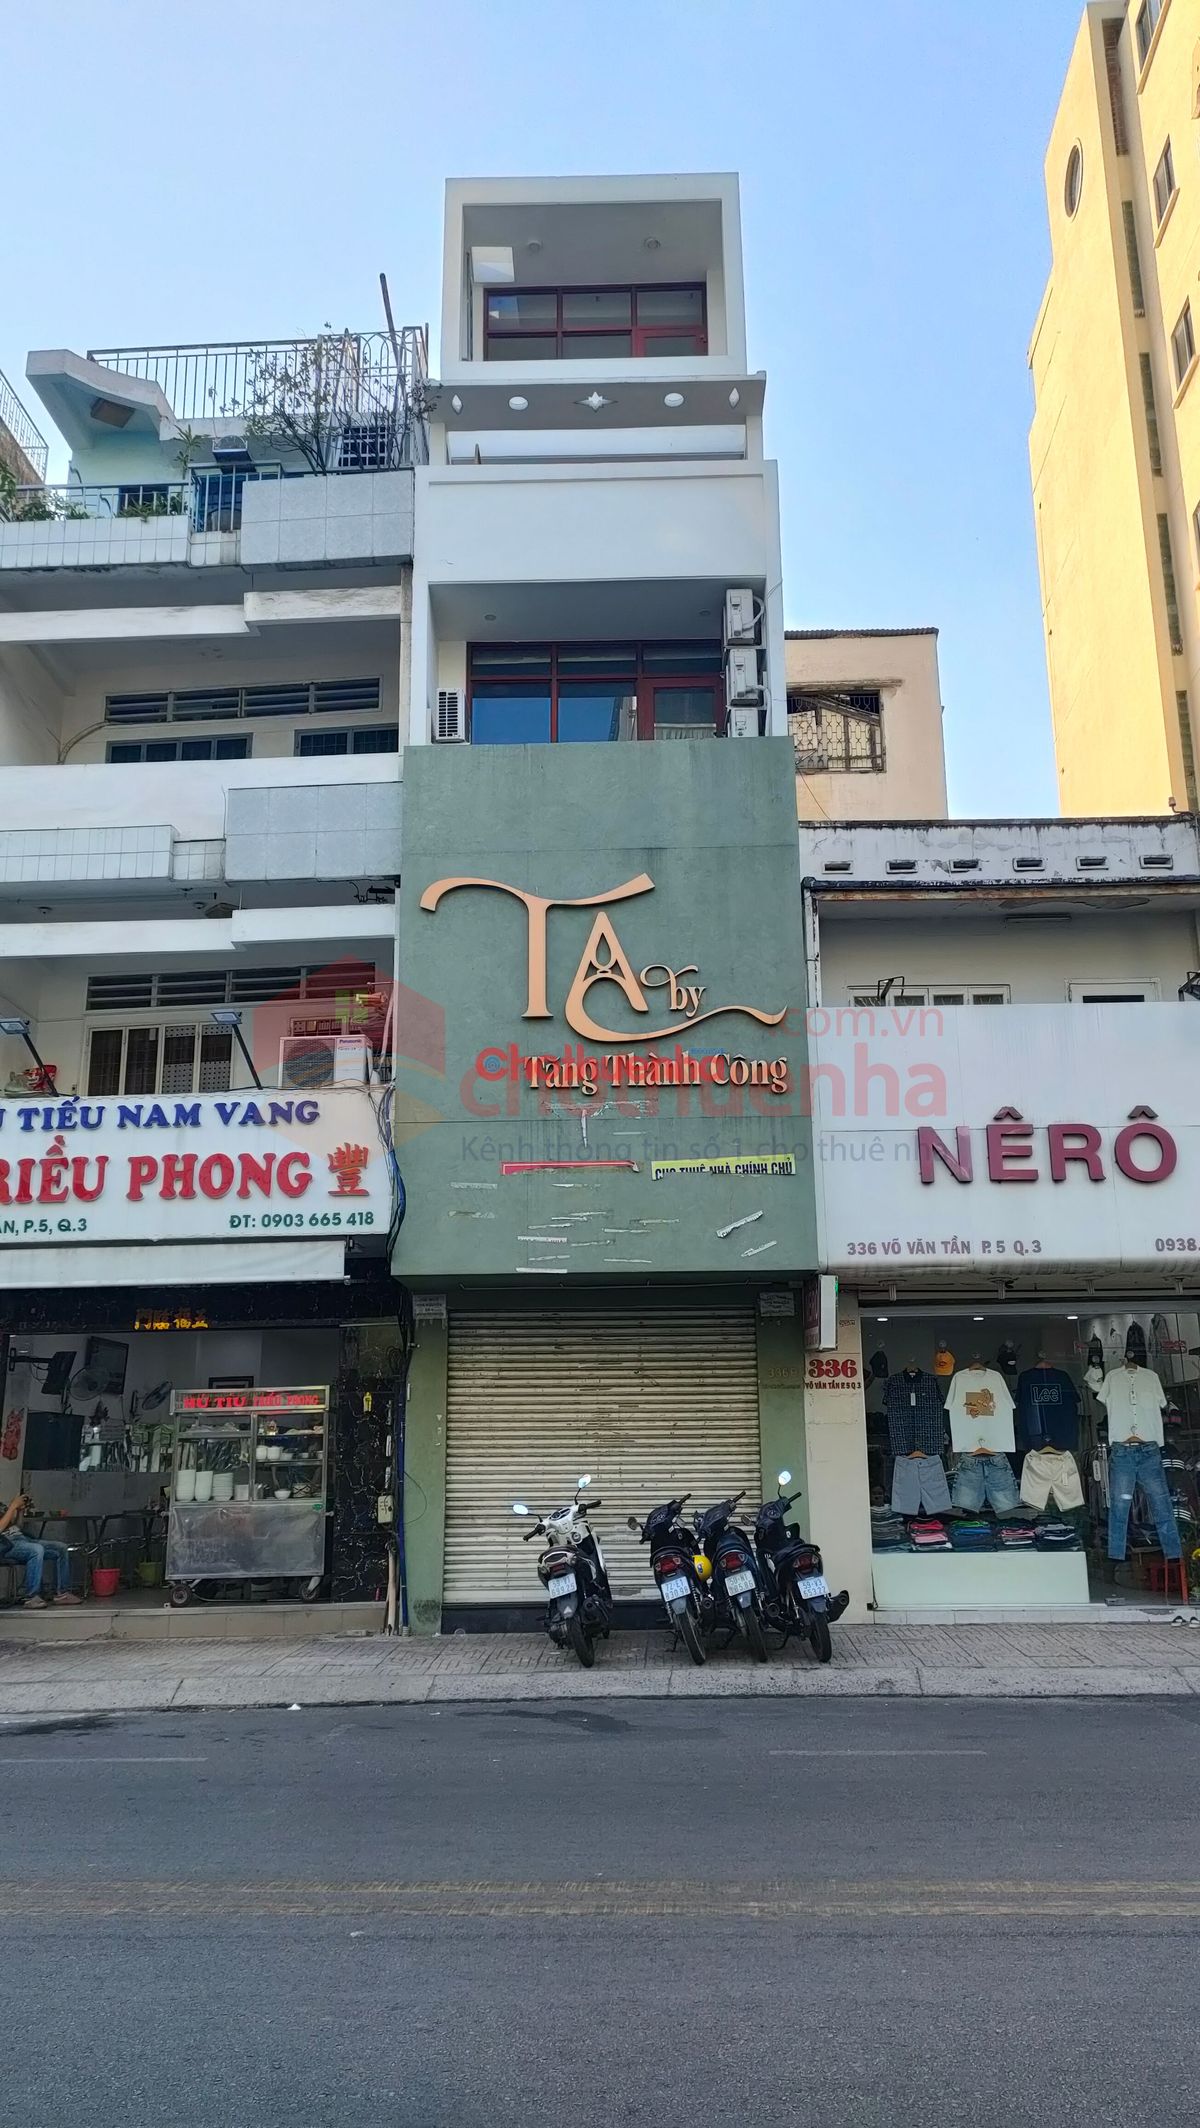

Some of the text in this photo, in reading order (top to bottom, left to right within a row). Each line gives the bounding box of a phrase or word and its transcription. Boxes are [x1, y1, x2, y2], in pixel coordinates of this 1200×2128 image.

[524, 1050, 787, 1096] Tăng Thành Công
[17, 1096, 106, 1131] TIẾU
[117, 1103, 202, 1129] NAM
[214, 1101, 321, 1126] VANG
[917, 1105, 1178, 1184] NÊRÔ
[126, 1151, 313, 1201] PHONG
[328, 1142, 370, 1197] 豐
[23, 1219, 53, 1235] P.5,
[57, 1218, 87, 1232] Q.3
[229, 1211, 374, 1228] ĐT: 0903 665 418
[847, 1241, 877, 1256] 336
[882, 1238, 901, 1255] VÕ
[906, 1238, 936, 1255] VĂN
[941, 1235, 971, 1254] TẦN
[808, 1359, 858, 1378] 336
[1032, 1386, 1059, 1402] Lee
